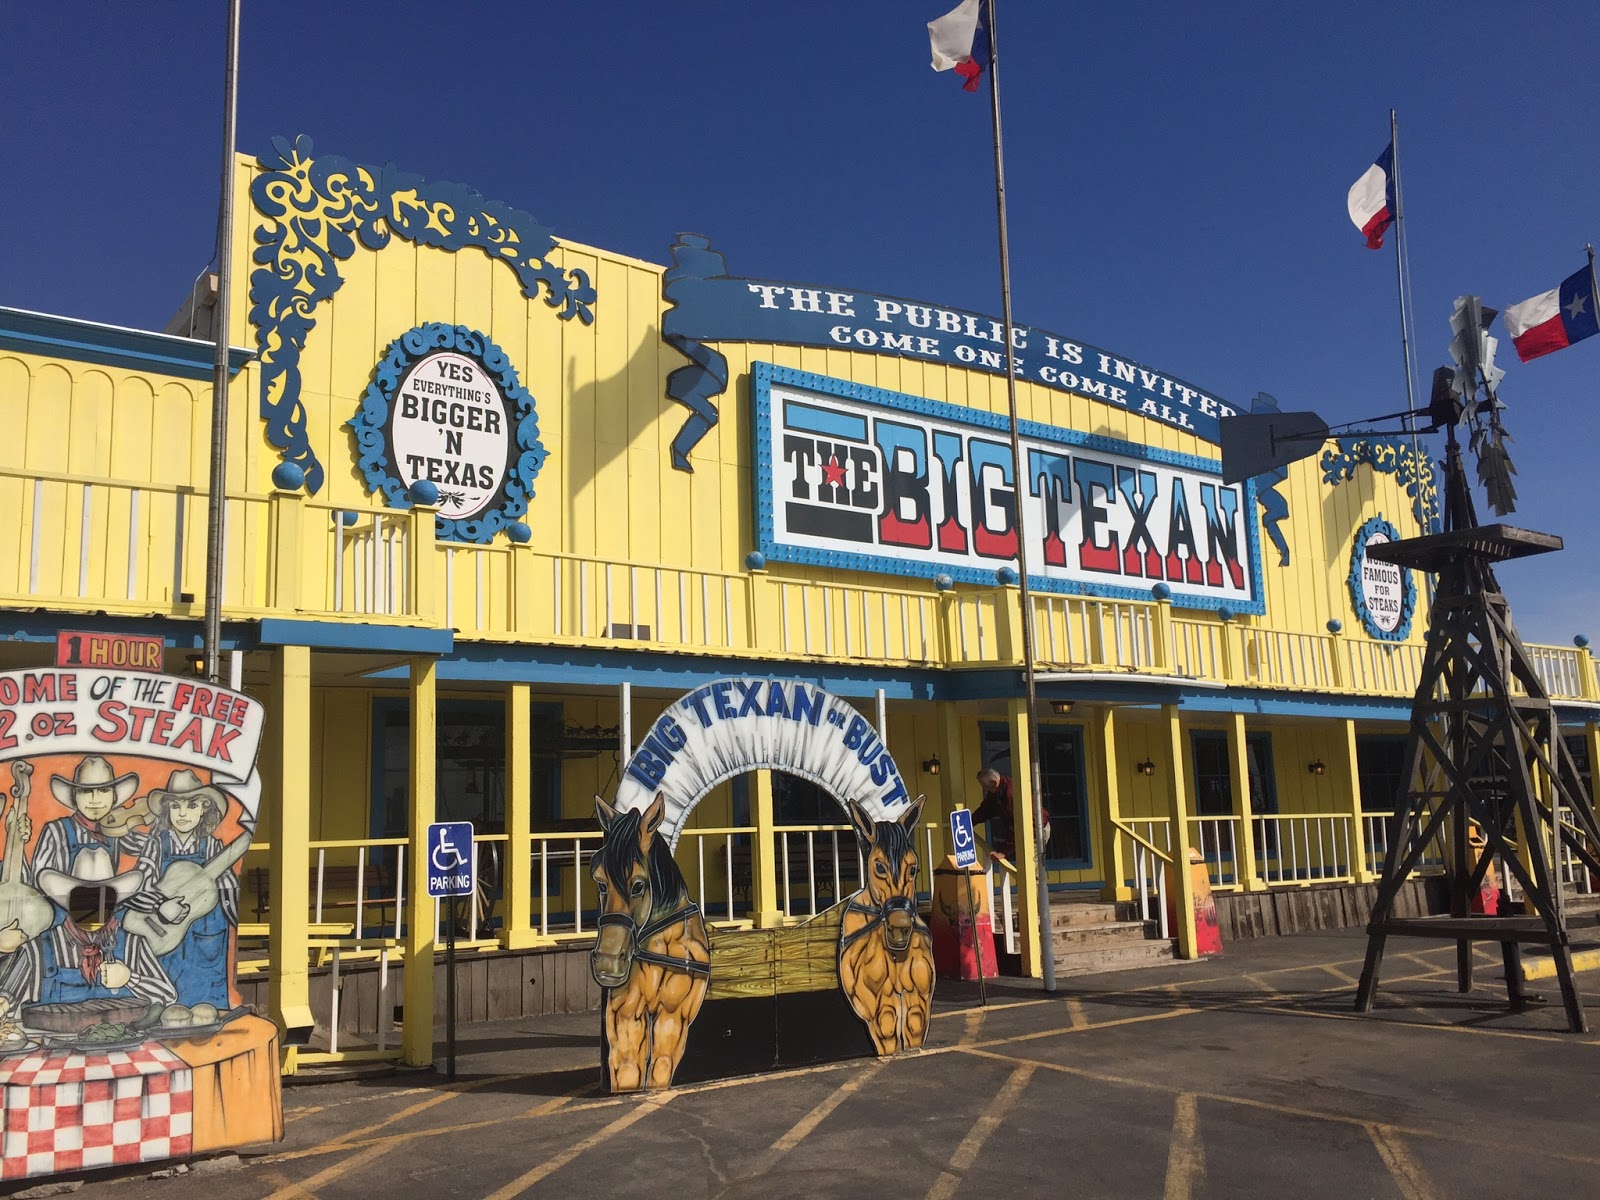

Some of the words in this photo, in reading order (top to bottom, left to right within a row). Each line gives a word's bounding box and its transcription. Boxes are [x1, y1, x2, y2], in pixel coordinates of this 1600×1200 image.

[747, 283, 856, 317] THE
[873, 299, 1027, 349] PUBLIC
[1045, 336, 1083, 365] IS
[437, 361, 473, 383] YES
[828, 325, 940, 356] COME
[953, 345, 1024, 375] ONE
[1039, 366, 1127, 405] COME
[1141, 398, 1195, 430] ALL
[413, 378, 491, 404] EVERYTHING'S
[401, 393, 501, 435] BIGGER
[406, 454, 494, 490] TEXAS
[783, 434, 878, 509] THE
[873, 417, 1022, 562] BIG
[1026, 447, 1245, 590] TEXAN
[1363, 567, 1398, 584] FAMOUS
[1374, 585, 1390, 595] FOR
[1369, 597, 1398, 612] STEAKS
[66, 636, 83, 664] 1
[89, 637, 161, 669] HOUR
[90, 675, 127, 700] OF
[133, 677, 172, 704] THE
[172, 682, 249, 728] FREE
[90, 701, 242, 763] STEAK
[627, 714, 688, 792] BIG
[680, 680, 826, 729] TEXAN
[826, 707, 846, 731] OR
[842, 713, 911, 808] BUST
[956, 849, 975, 862] PARKING
[430, 875, 470, 890] PARKING
